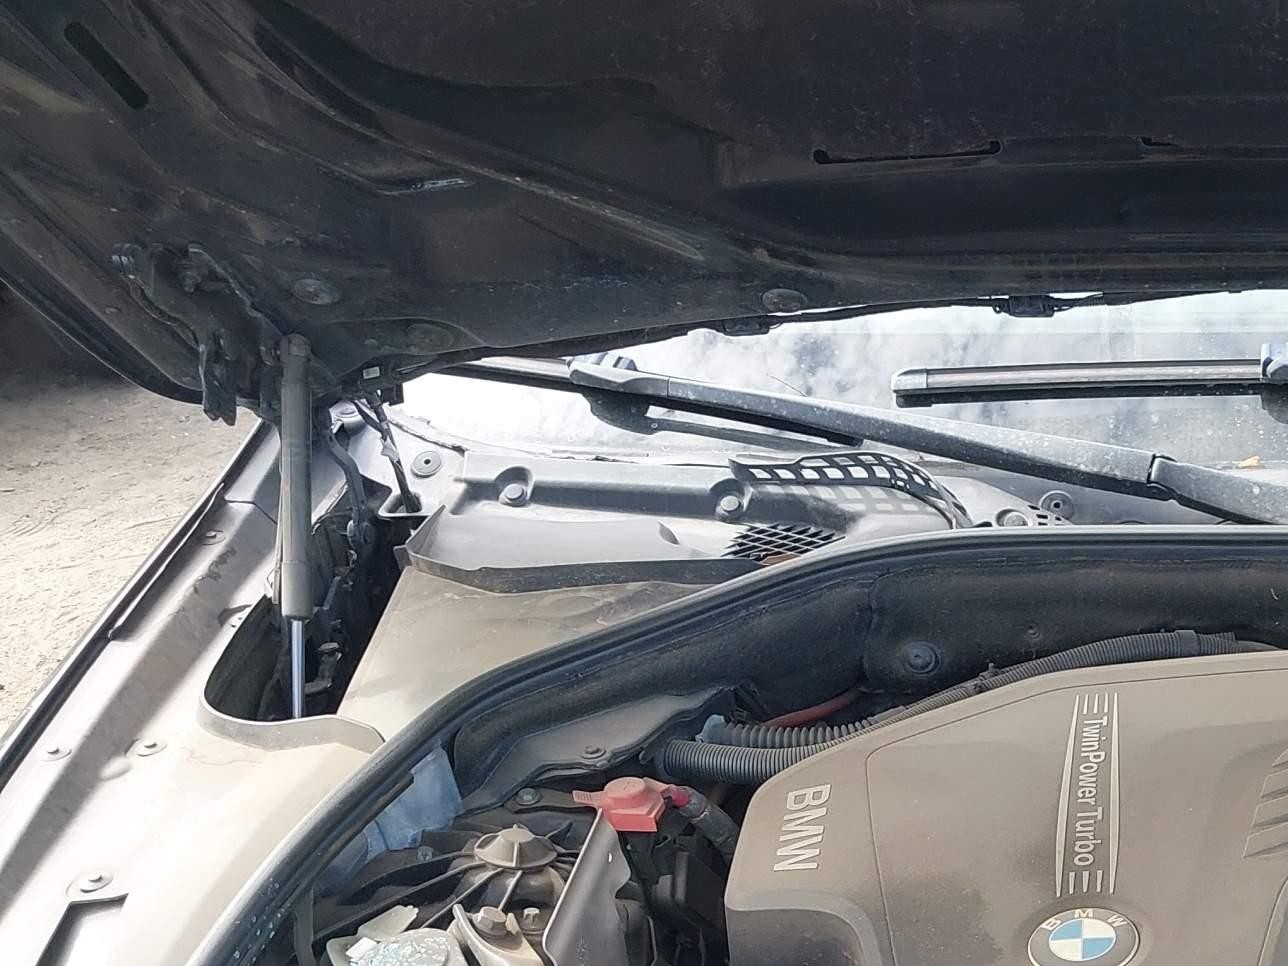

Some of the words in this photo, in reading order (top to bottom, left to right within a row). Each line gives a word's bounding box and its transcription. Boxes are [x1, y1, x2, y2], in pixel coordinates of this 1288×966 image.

[1076, 715, 1109, 804] TwinPower
[774, 783, 832, 872] BMW
[1073, 807, 1105, 866] Turbo
[1040, 908, 1128, 931] BMW
